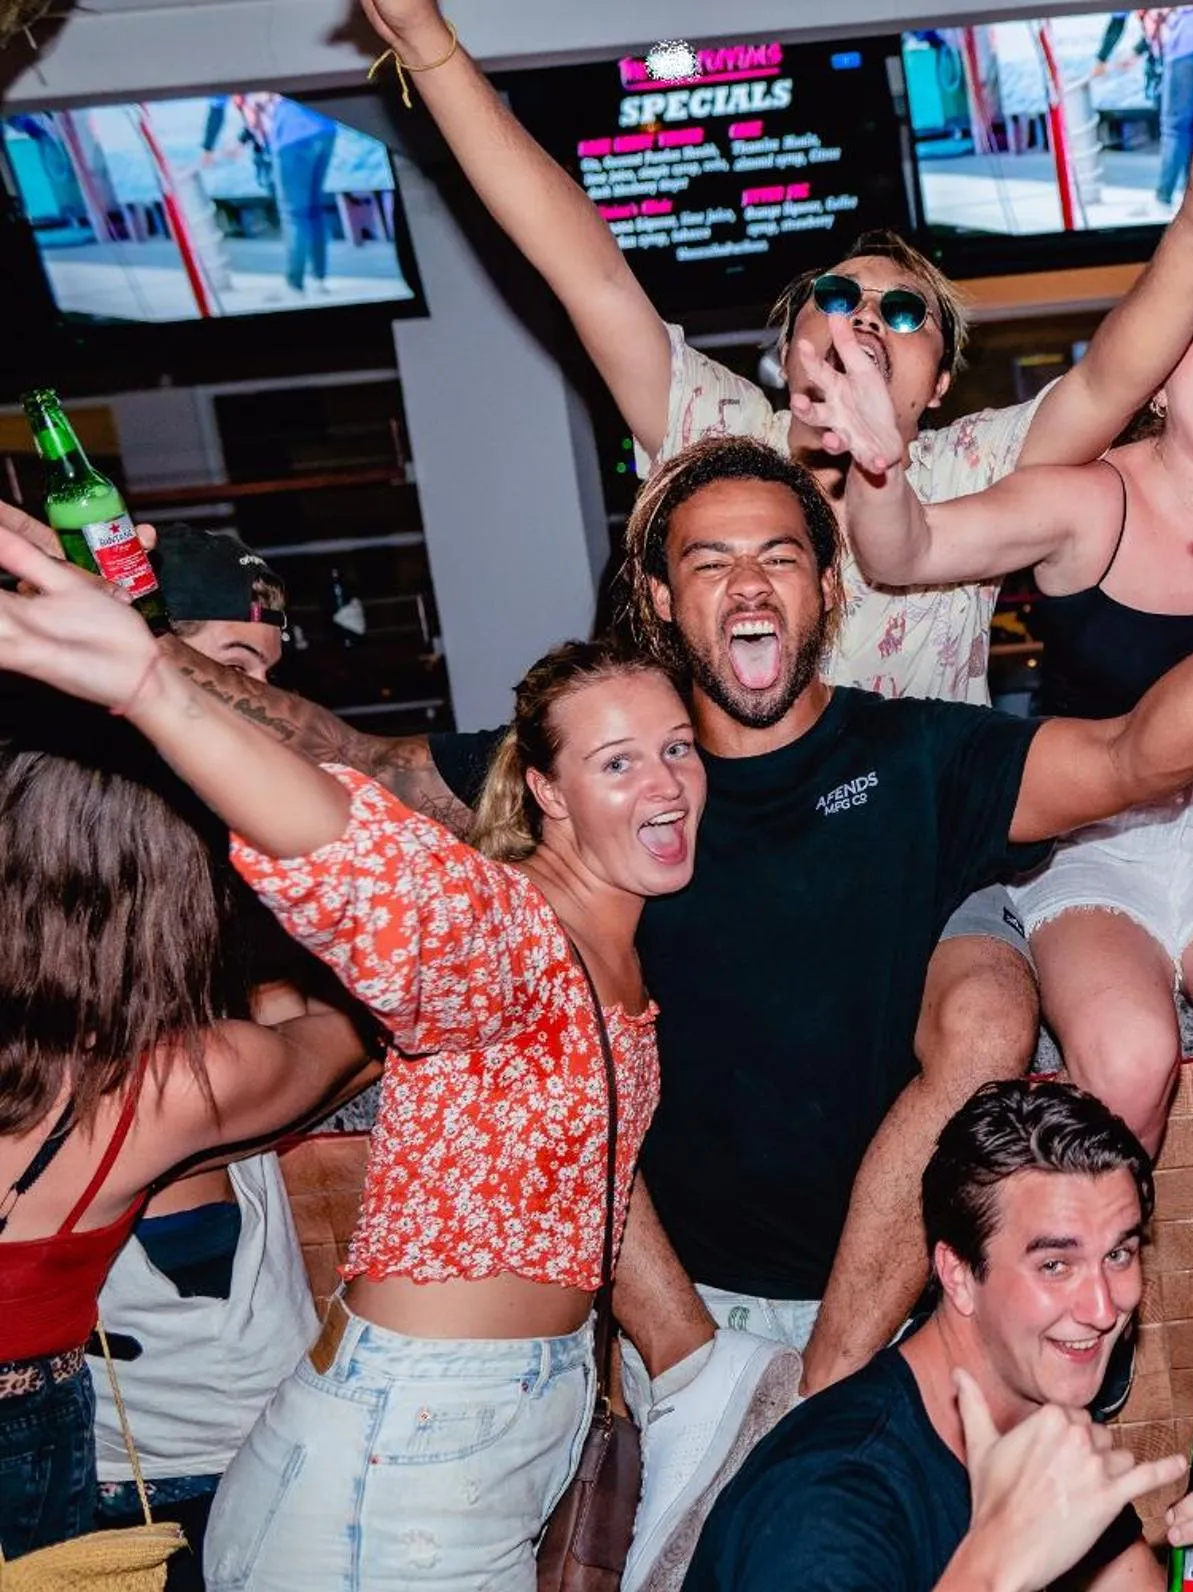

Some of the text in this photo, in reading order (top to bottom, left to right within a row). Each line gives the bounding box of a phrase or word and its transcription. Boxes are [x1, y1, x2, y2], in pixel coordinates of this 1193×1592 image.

[619, 78, 793, 128] SPECIALS
[815, 771, 879, 810] AFENDS
[824, 798, 850, 816] MFG
